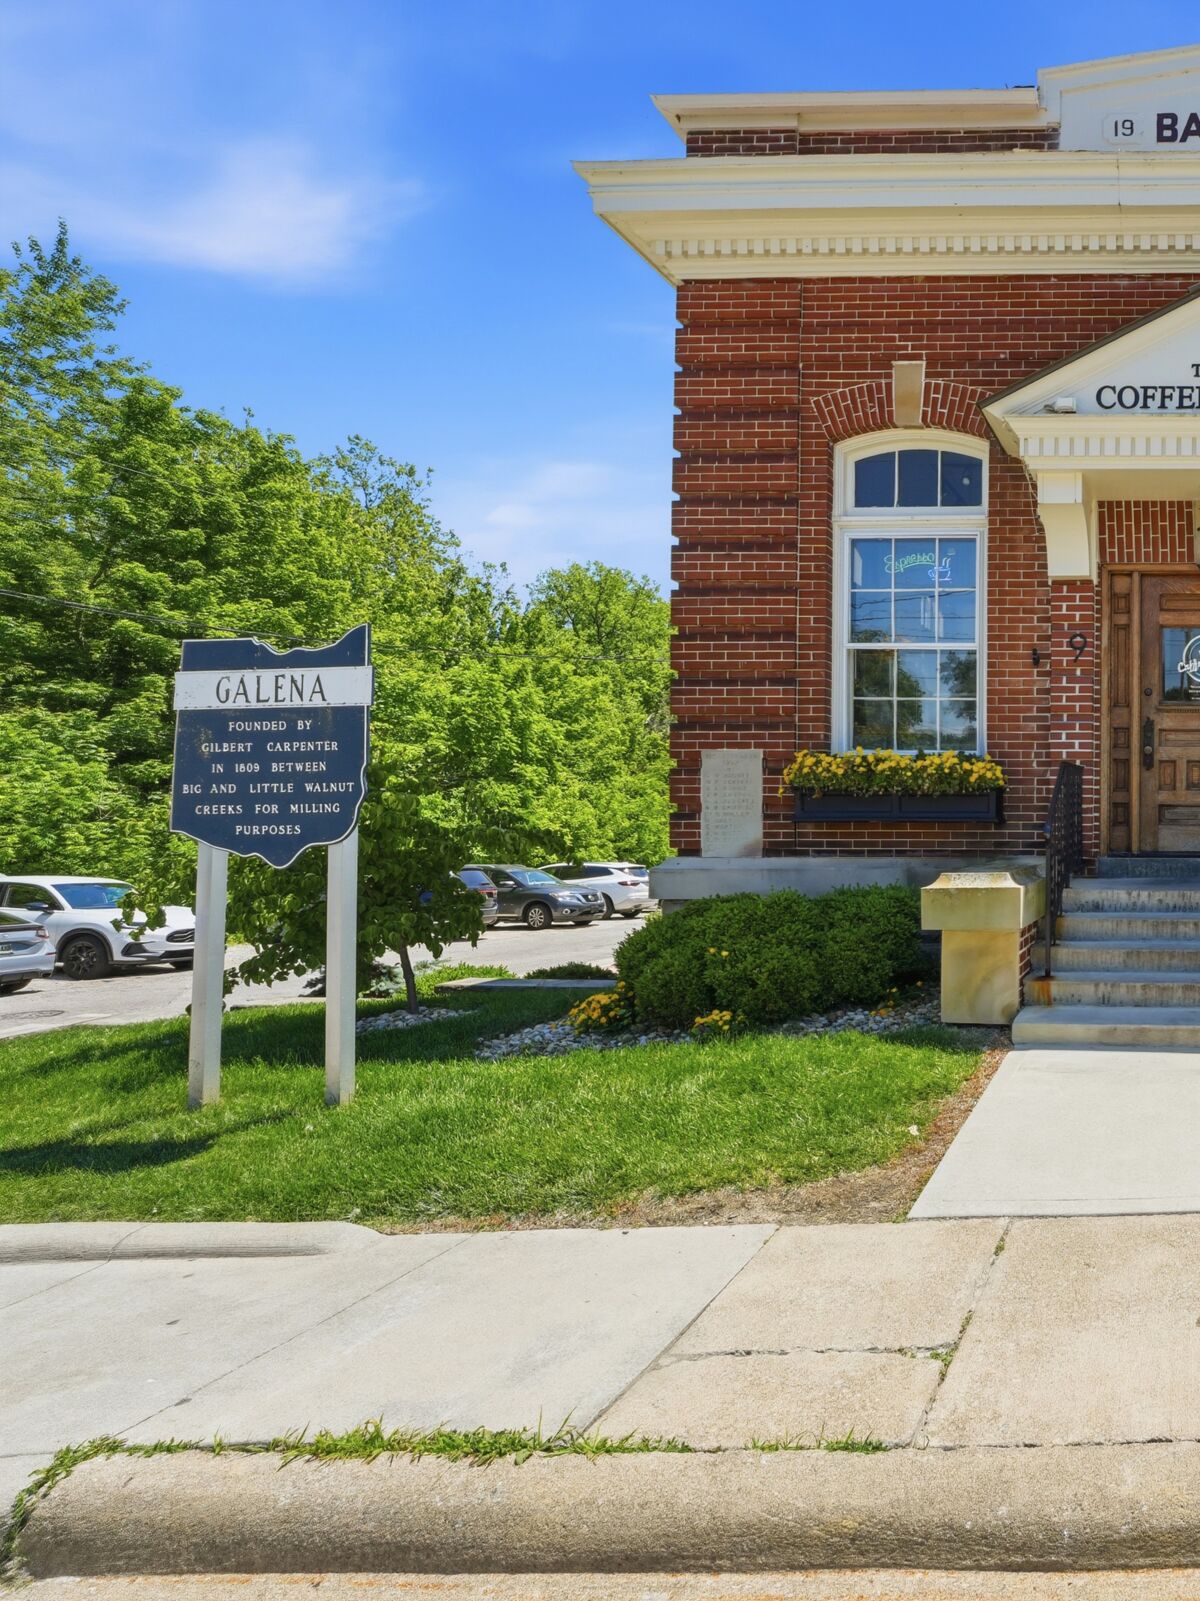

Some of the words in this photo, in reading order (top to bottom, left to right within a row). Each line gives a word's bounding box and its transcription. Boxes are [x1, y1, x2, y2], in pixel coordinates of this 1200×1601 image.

[1113, 119, 1135, 137] 19
[1069, 632, 1087, 663] 9
[215, 673, 327, 704] GALENA
[228, 720, 287, 731] FOUNDED
[297, 719, 313, 730] BY
[201, 742, 254, 753] GILBERT
[266, 741, 339, 752] CARPENTER
[211, 763, 224, 774] IN
[235, 763, 260, 773] 1809
[271, 761, 327, 772] BETWEEN
[182, 784, 202, 794] BIG
[210, 784, 237, 794] AND
[249, 783, 294, 793] LITTLE
[304, 782, 355, 792] WALNUT
[195, 804, 243, 815] CREEKS
[255, 804, 279, 814] FOR
[290, 803, 340, 814] MILLING
[235, 825, 301, 835] PURPOSES
